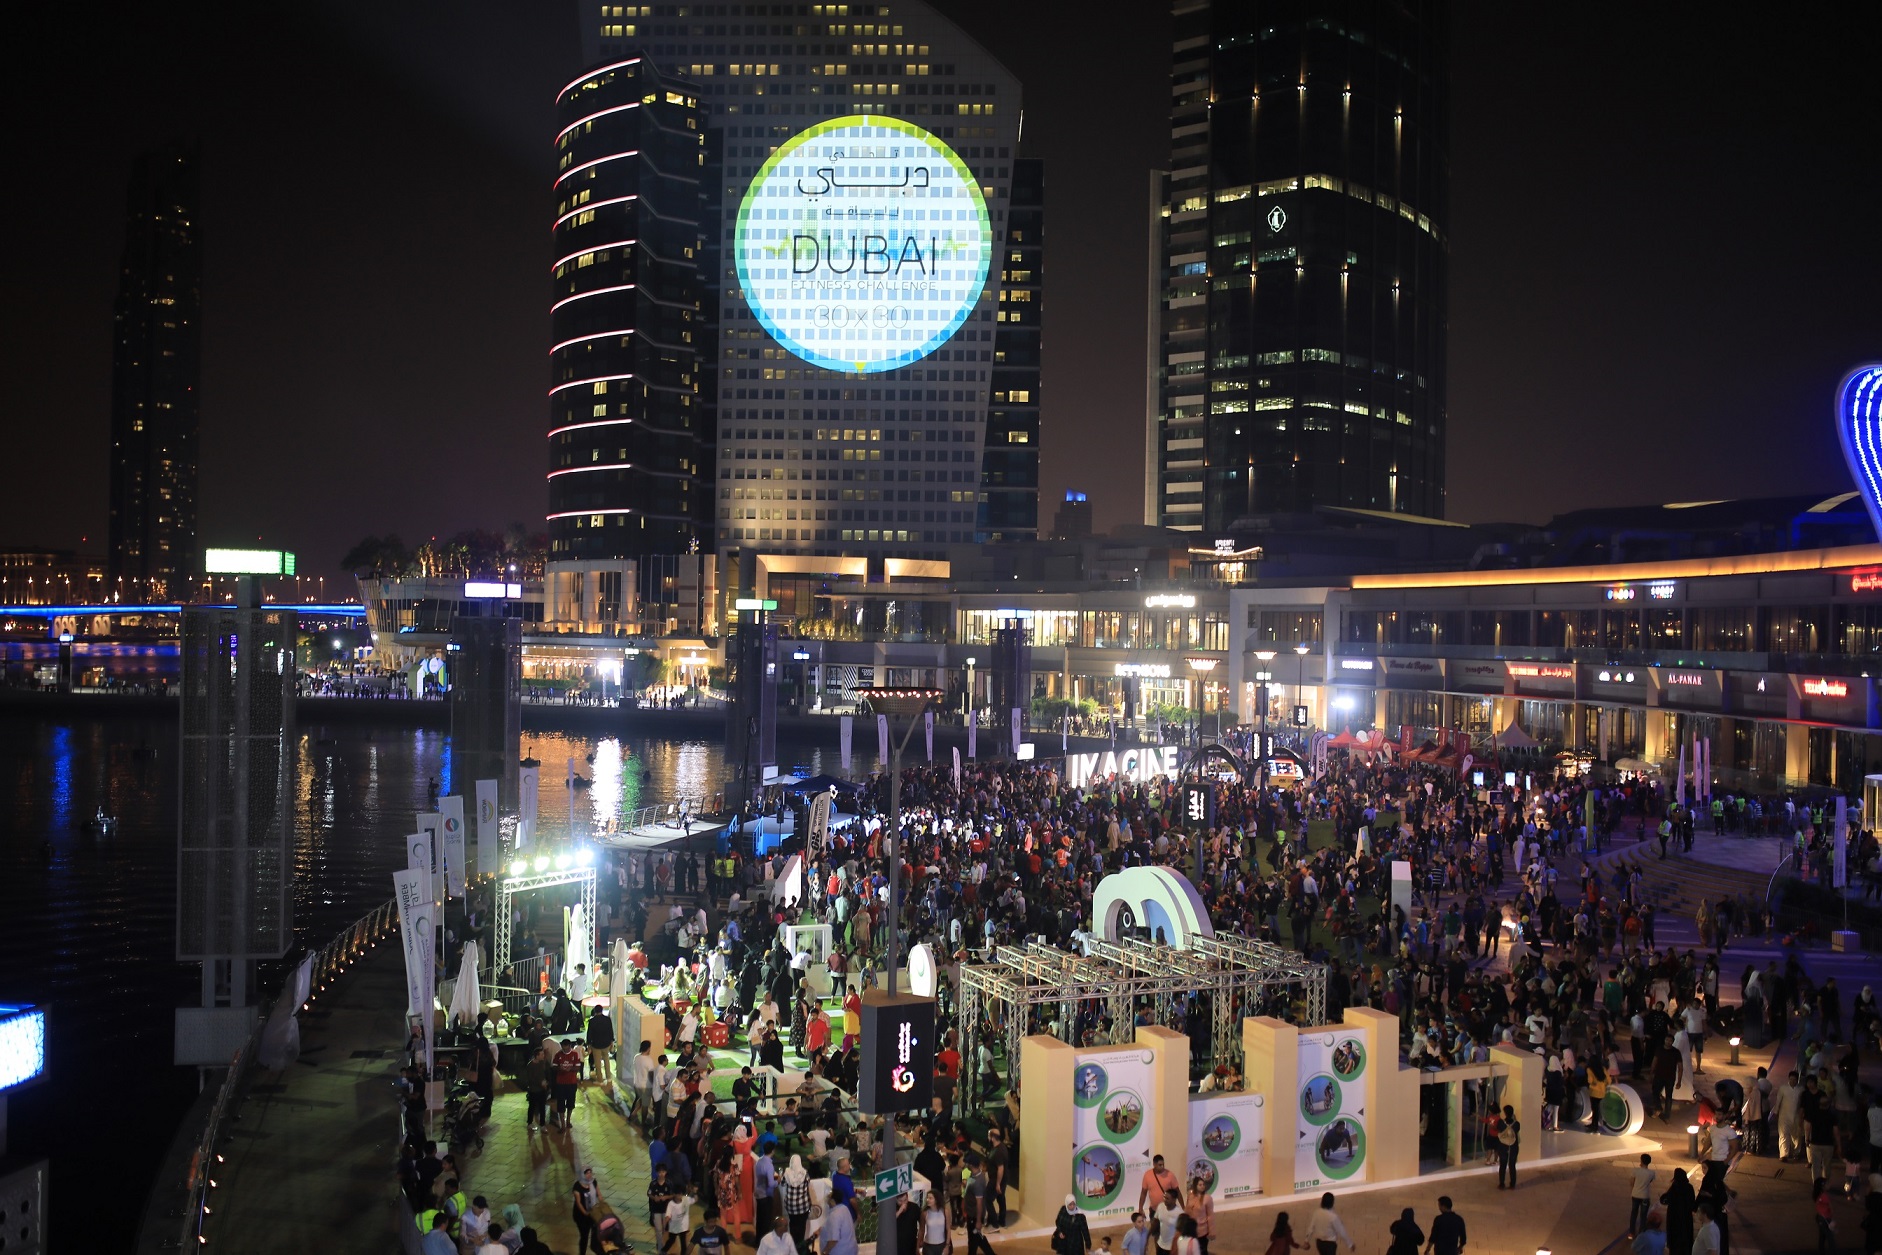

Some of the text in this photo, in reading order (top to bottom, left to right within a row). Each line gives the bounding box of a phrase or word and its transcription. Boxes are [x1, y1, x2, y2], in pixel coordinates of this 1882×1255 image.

[797, 166, 930, 202] دبي
[792, 234, 936, 275] DUBAI
[791, 280, 937, 291] FITNESS CHALLENGE
[1072, 746, 1178, 788] IMAGINE
